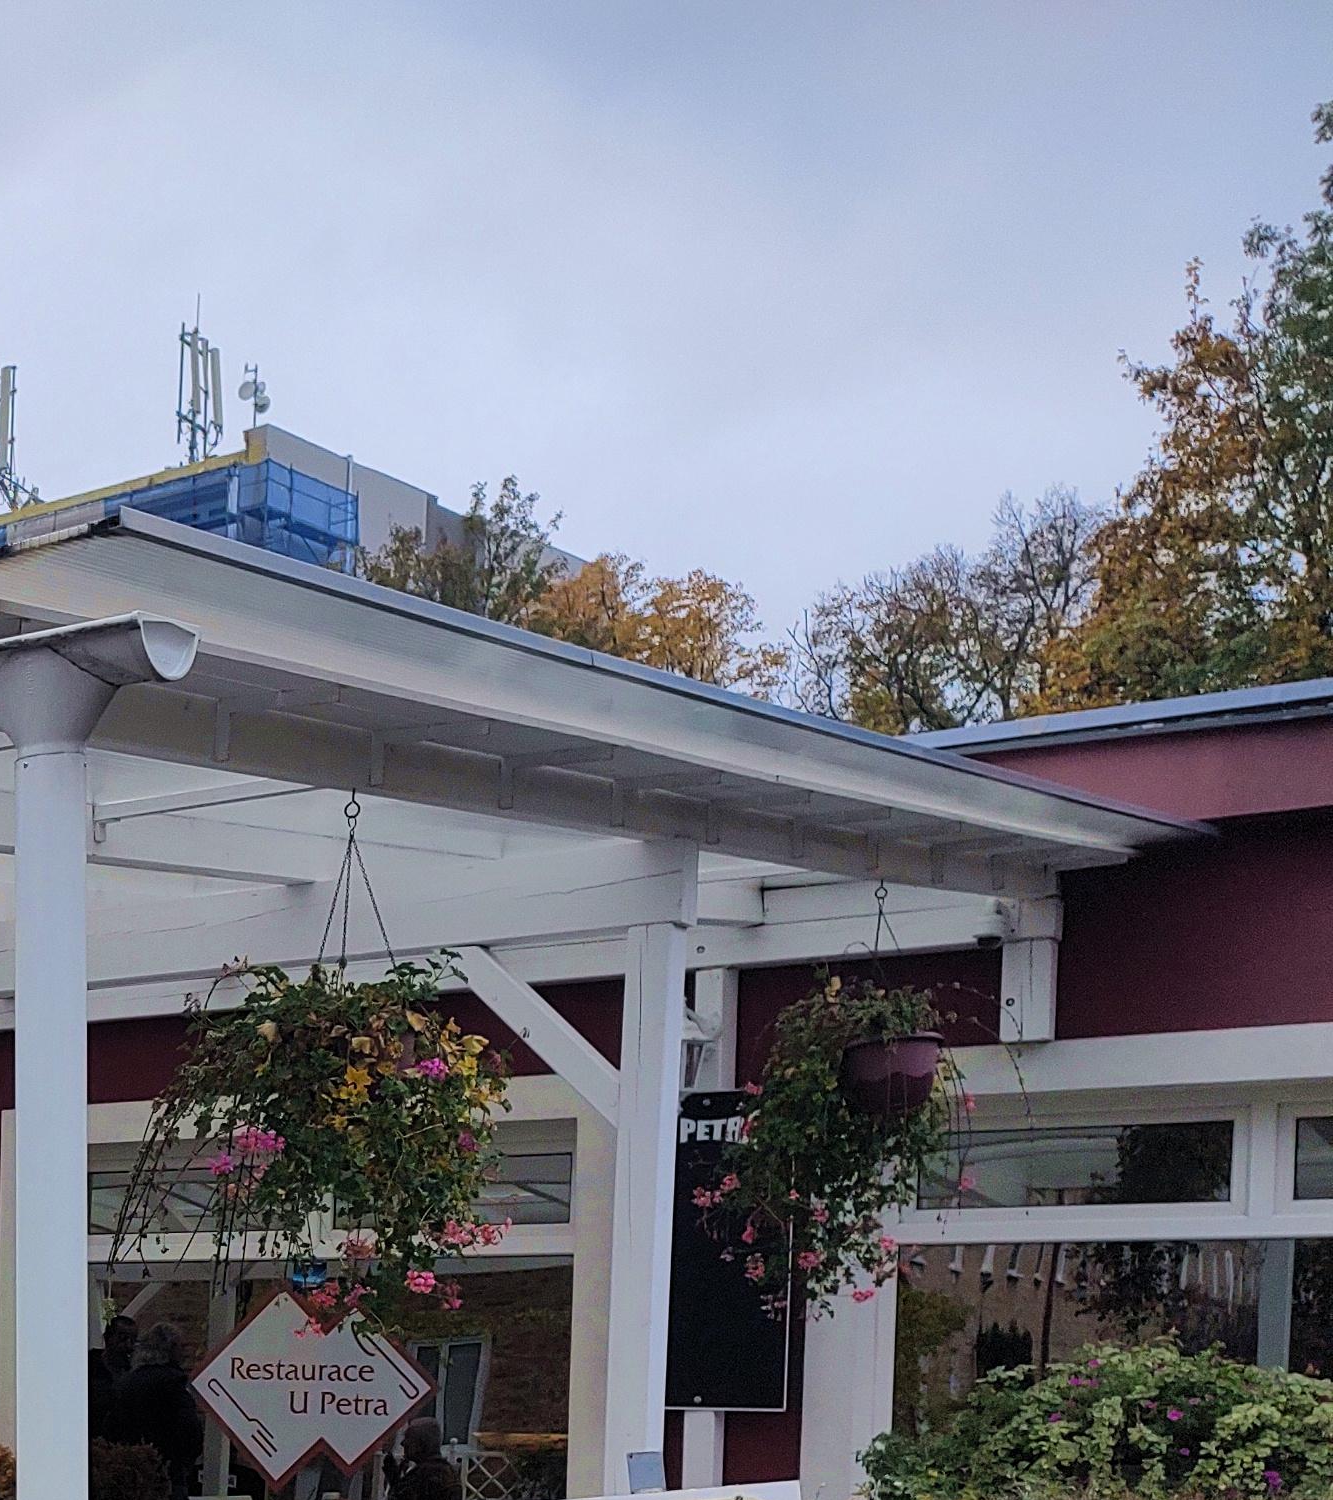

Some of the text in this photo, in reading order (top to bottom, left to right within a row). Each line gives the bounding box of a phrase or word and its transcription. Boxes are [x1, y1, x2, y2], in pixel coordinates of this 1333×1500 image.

[680, 1116, 742, 1144] PETR
[230, 1357, 375, 1382] Restaurace
[289, 1391, 389, 1416] U Petra
